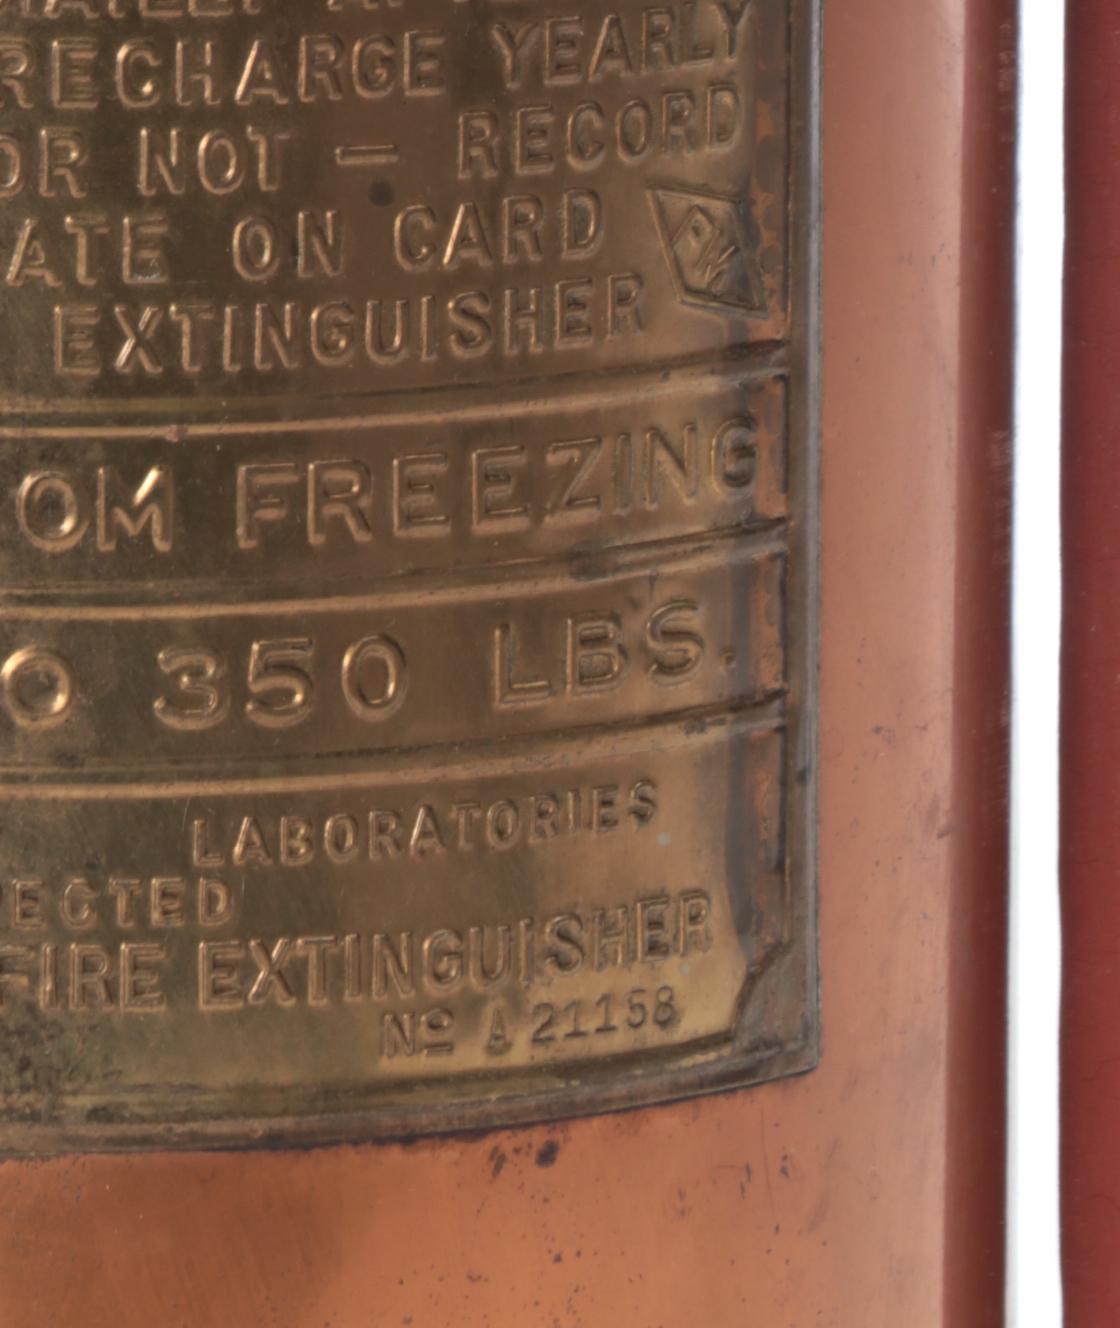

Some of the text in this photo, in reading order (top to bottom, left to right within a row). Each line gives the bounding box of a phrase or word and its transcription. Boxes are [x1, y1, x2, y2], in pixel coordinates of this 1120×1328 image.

[136, 126, 291, 195] NOT
[457, 83, 744, 181] RECORD
[231, 209, 345, 281] ON
[394, 187, 603, 272] CARD
[53, 271, 644, 375] EXTINGUISHER
[236, 418, 758, 550] FREEZING
[154, 634, 408, 730] 350
[191, 778, 658, 869] LABORATORIES
[198, 888, 713, 1012] EXTINGUISHER
